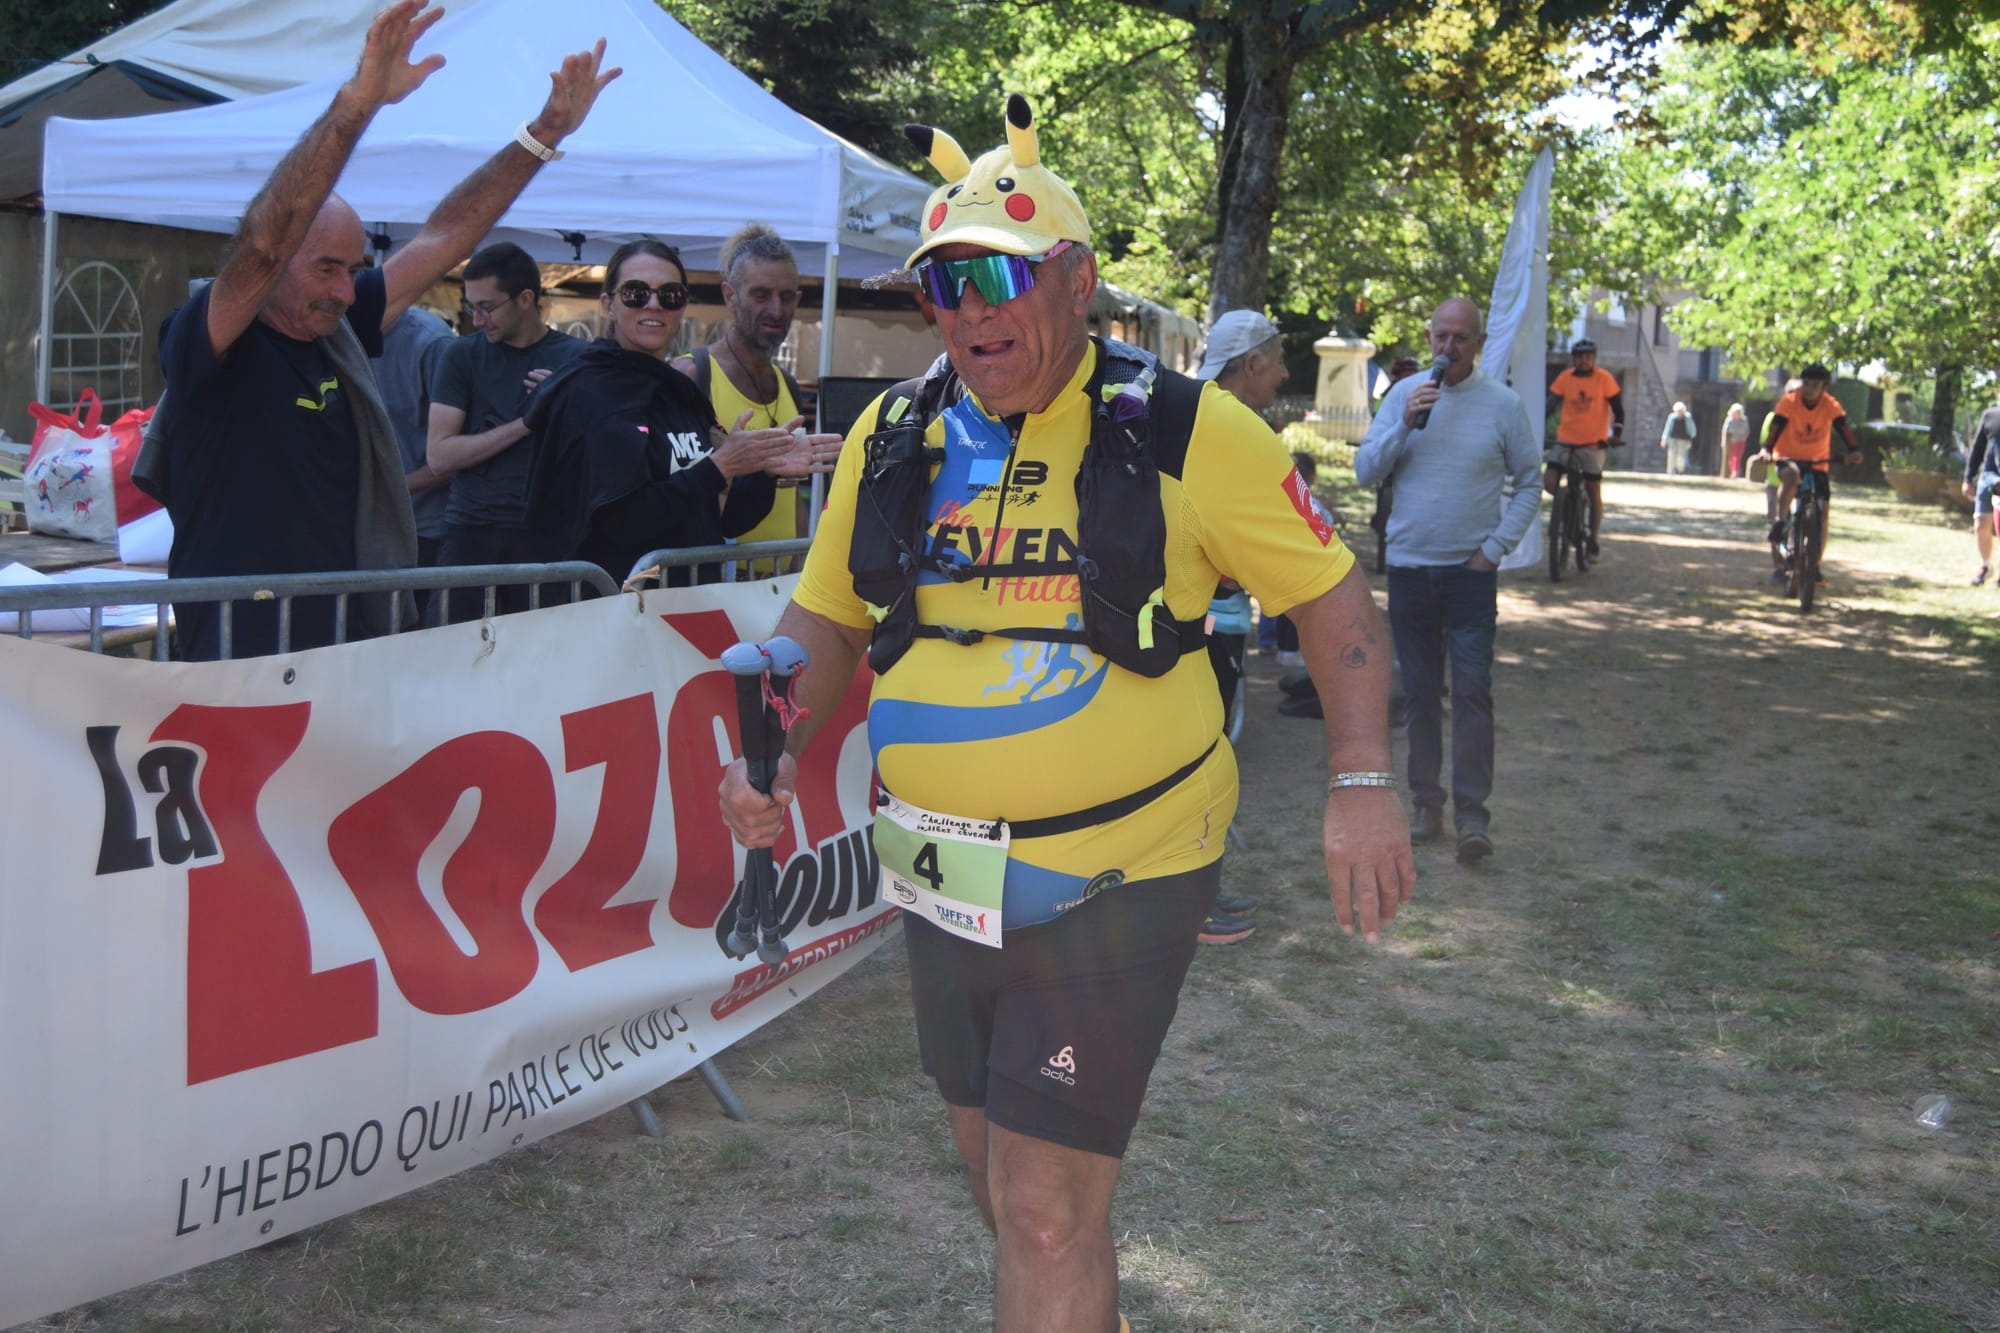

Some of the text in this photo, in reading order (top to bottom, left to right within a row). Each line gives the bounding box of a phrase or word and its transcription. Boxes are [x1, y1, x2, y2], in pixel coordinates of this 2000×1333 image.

[967, 484, 1024, 493] RUNNING
[934, 499, 974, 528] the
[996, 576, 1081, 606] Hills
[86, 725, 218, 876] La
[920, 813, 972, 830] Challenge
[913, 842, 944, 891] 4
[934, 903, 974, 925] TUFF'S
[940, 913, 979, 933] Aventure
[1040, 1066, 1076, 1086] odlo
[176, 998, 693, 1236] L'HEBDO QUI PARLE DE VOUS
